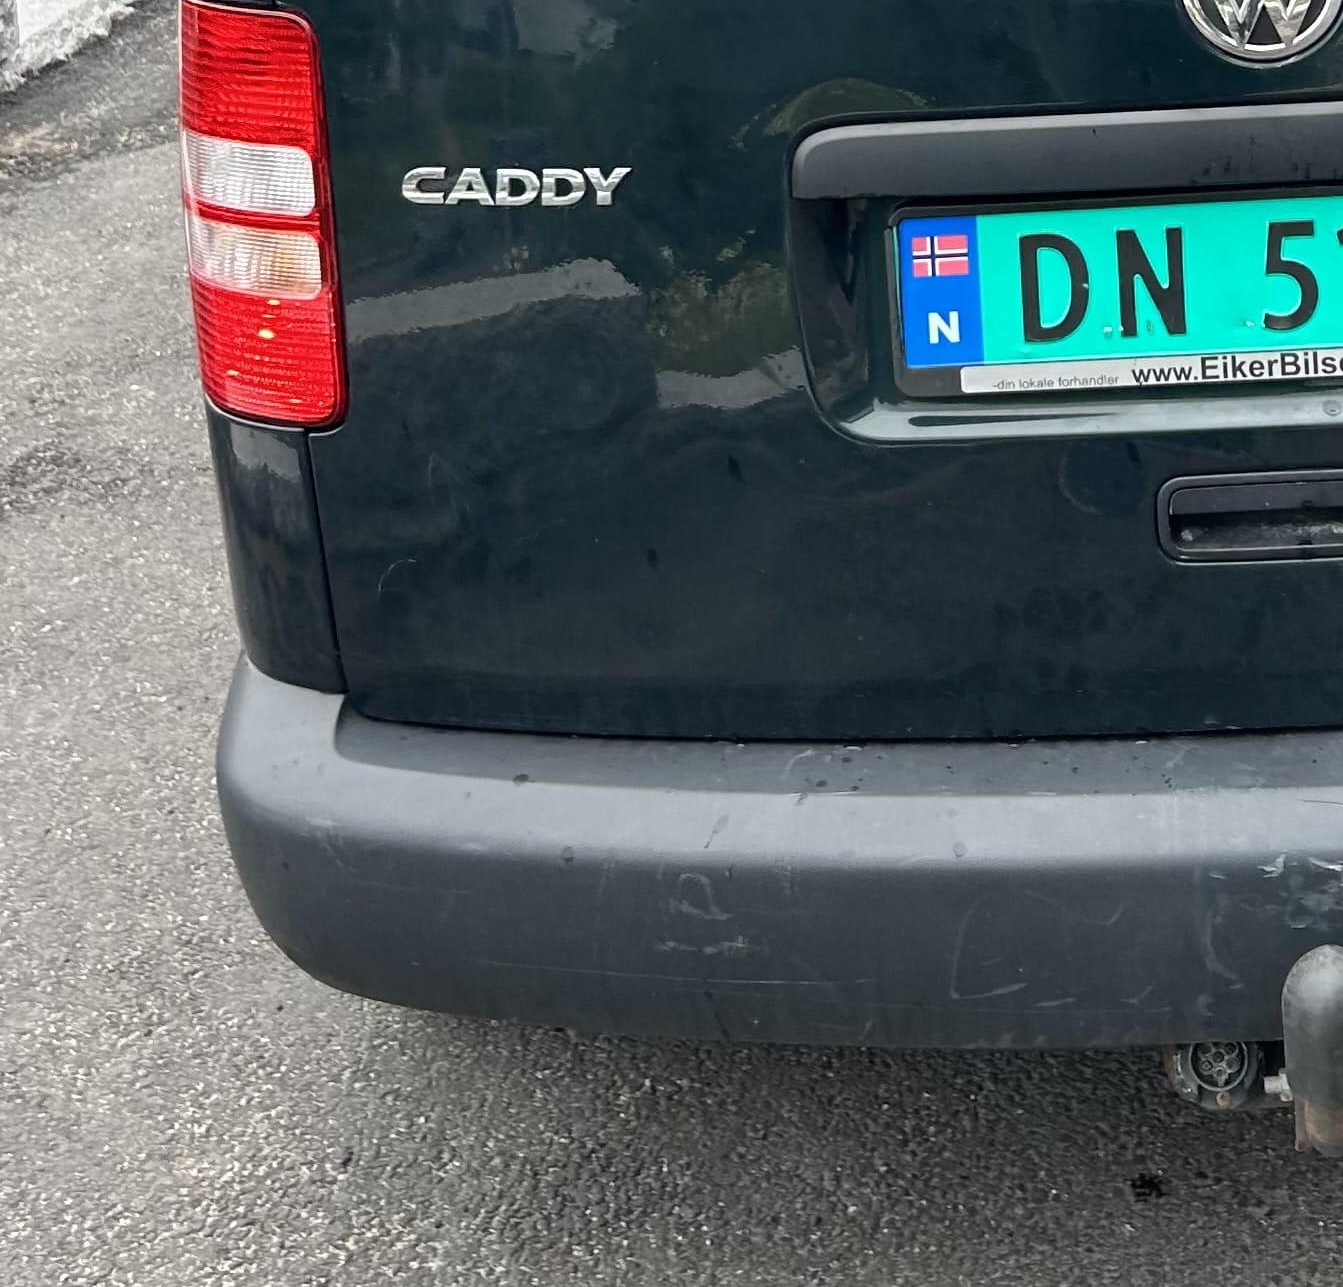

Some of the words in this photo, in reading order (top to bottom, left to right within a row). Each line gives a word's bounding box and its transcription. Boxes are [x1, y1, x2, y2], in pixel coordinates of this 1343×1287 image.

[401, 166, 633, 206] CADDY
[1018, 226, 1187, 344] DN
[927, 310, 961, 344] N
[1019, 377, 1055, 390] lokale
[1058, 373, 1120, 388] forhandler
